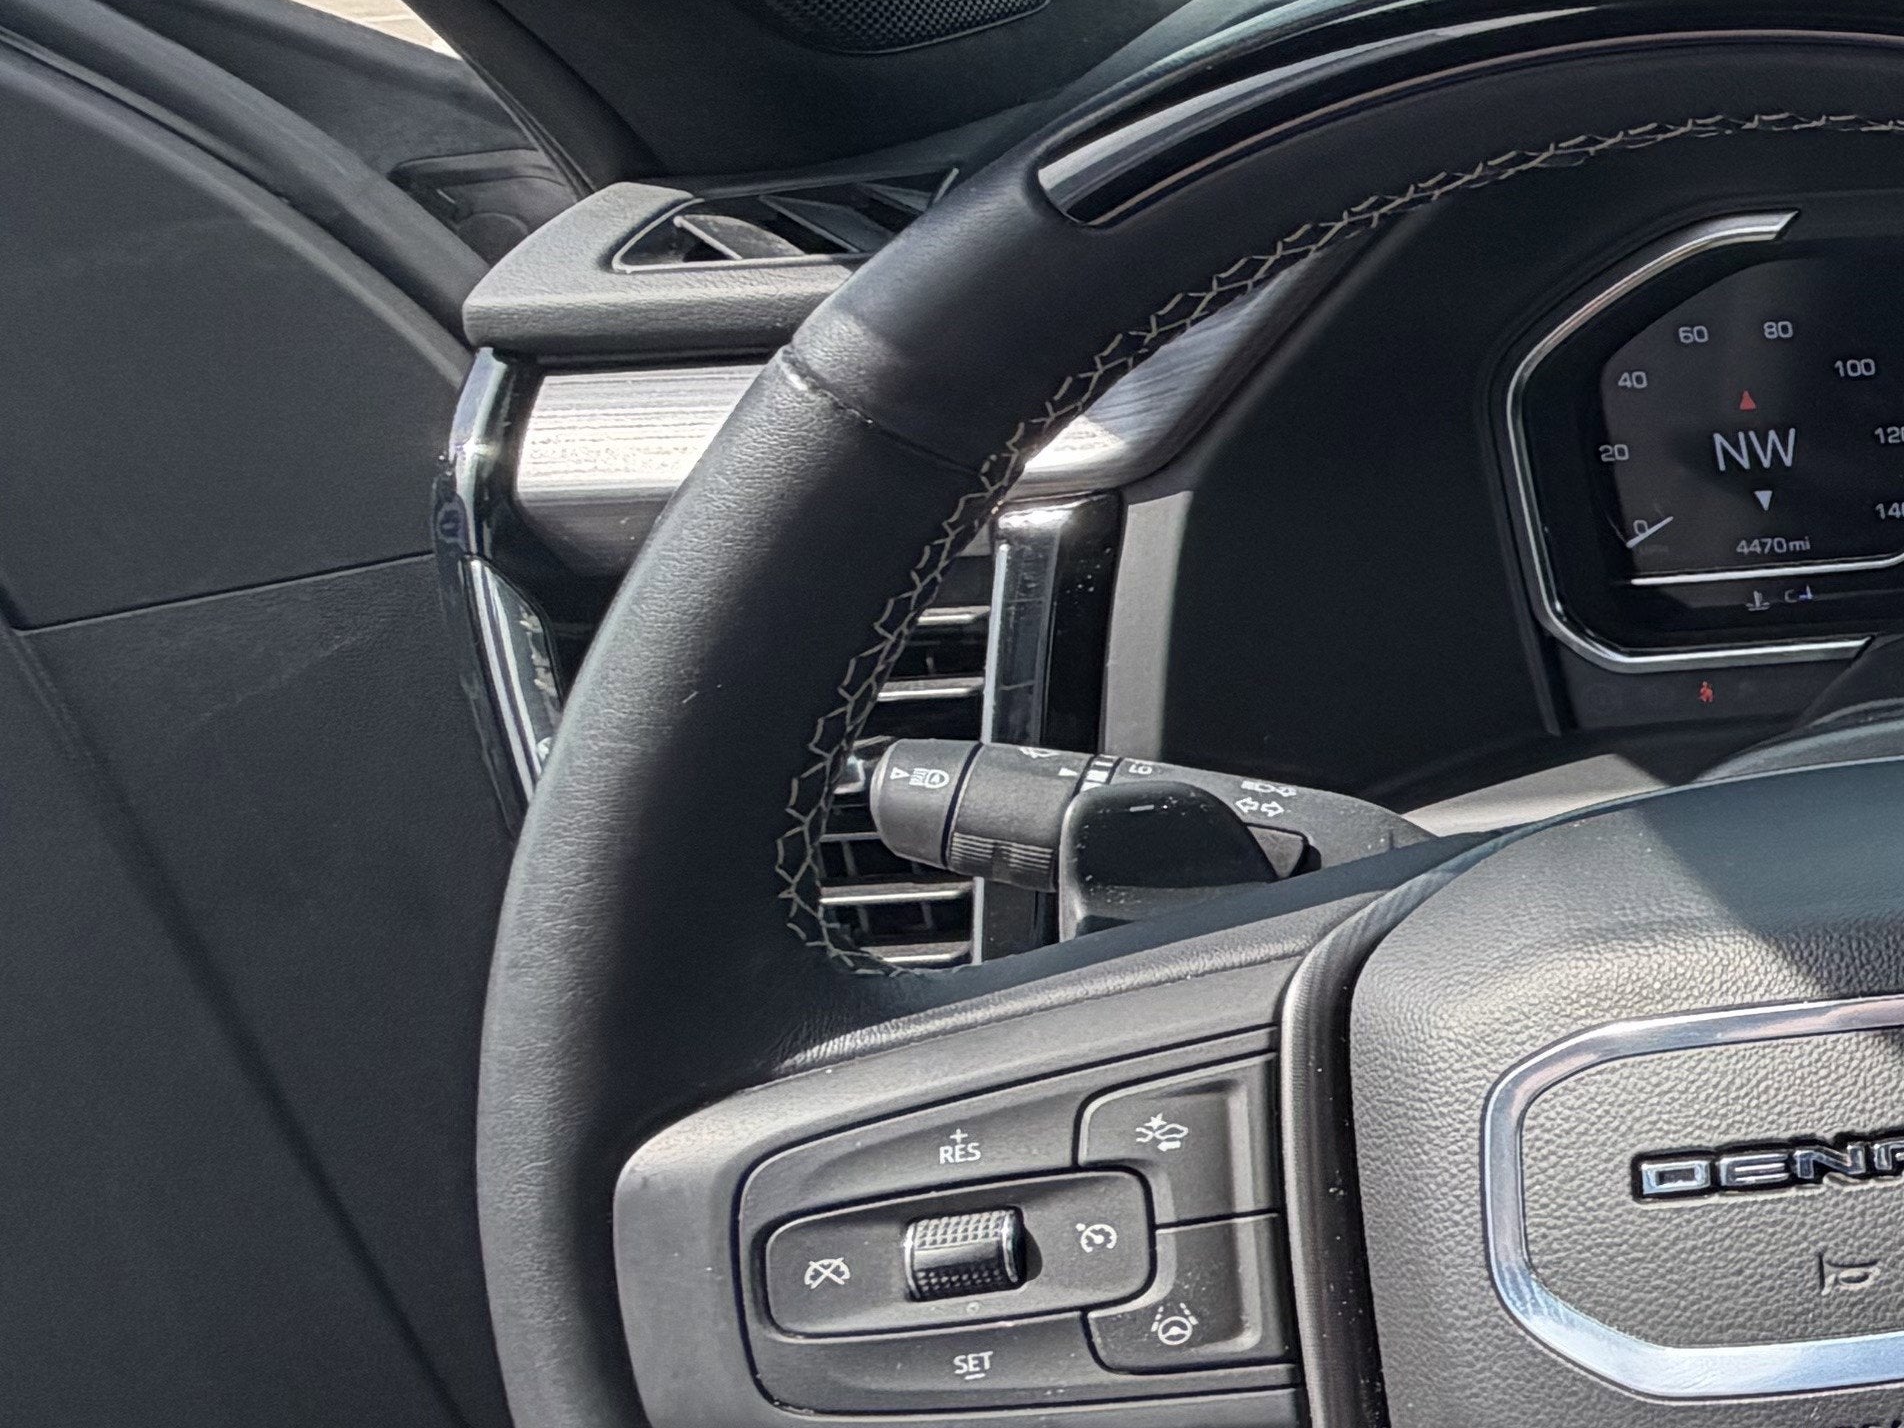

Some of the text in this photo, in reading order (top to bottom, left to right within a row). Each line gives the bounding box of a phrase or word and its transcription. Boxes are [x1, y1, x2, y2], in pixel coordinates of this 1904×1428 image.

[1679, 324, 1710, 344] 60
[1763, 320, 1794, 340] 80
[1834, 357, 1876, 378] 100
[1618, 370, 1648, 390] 40
[1600, 443, 1629, 463] 20
[1713, 427, 1796, 472] NW
[938, 1142, 982, 1165] RES
[953, 1351, 993, 1374] SET
